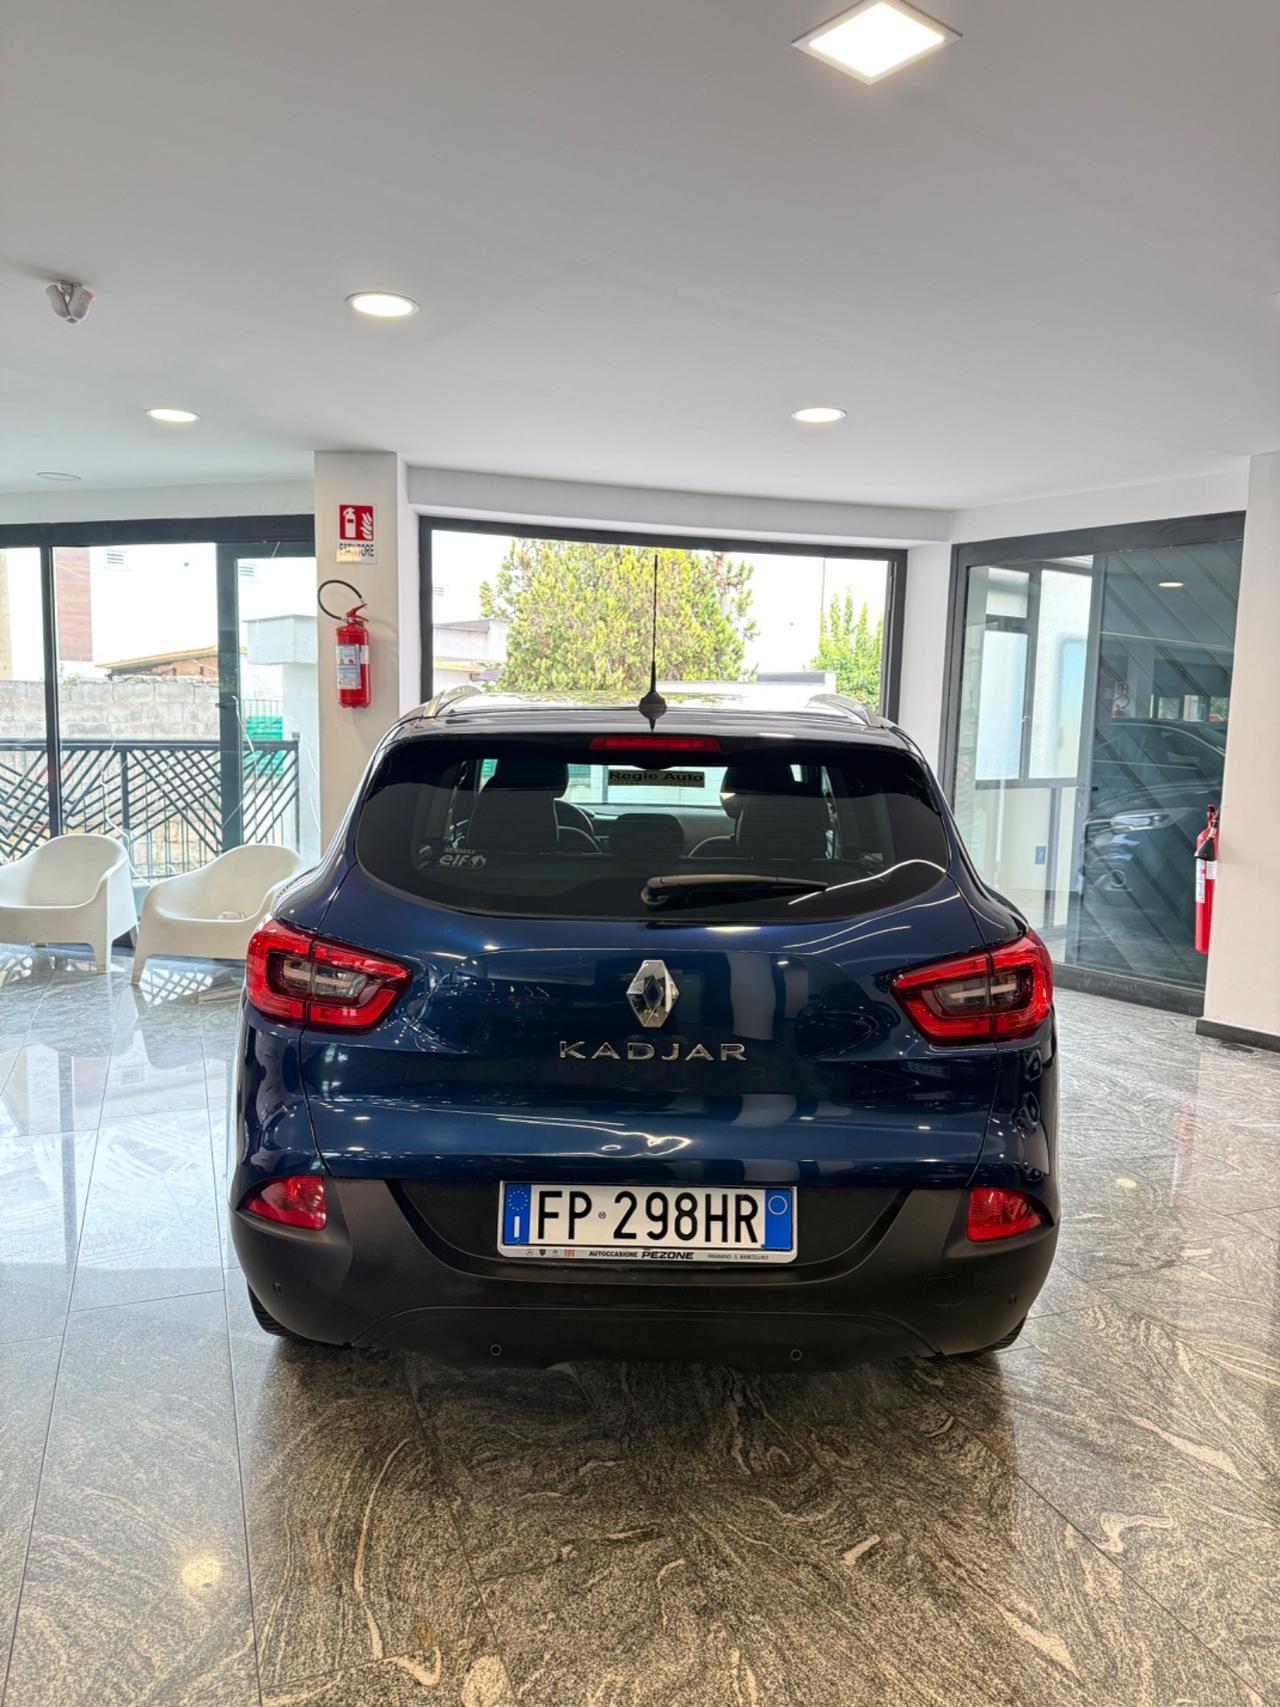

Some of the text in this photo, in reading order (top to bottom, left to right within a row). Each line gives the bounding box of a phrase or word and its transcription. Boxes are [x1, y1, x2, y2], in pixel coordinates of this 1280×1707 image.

[663, 773, 704, 782] Auto
[439, 854, 471, 866] elf
[559, 1040, 747, 1061] KADJAR
[538, 1190, 592, 1240] FP
[613, 1190, 758, 1243] 298HR
[589, 1250, 694, 1260] AUTOCCASIONE PEZONE
